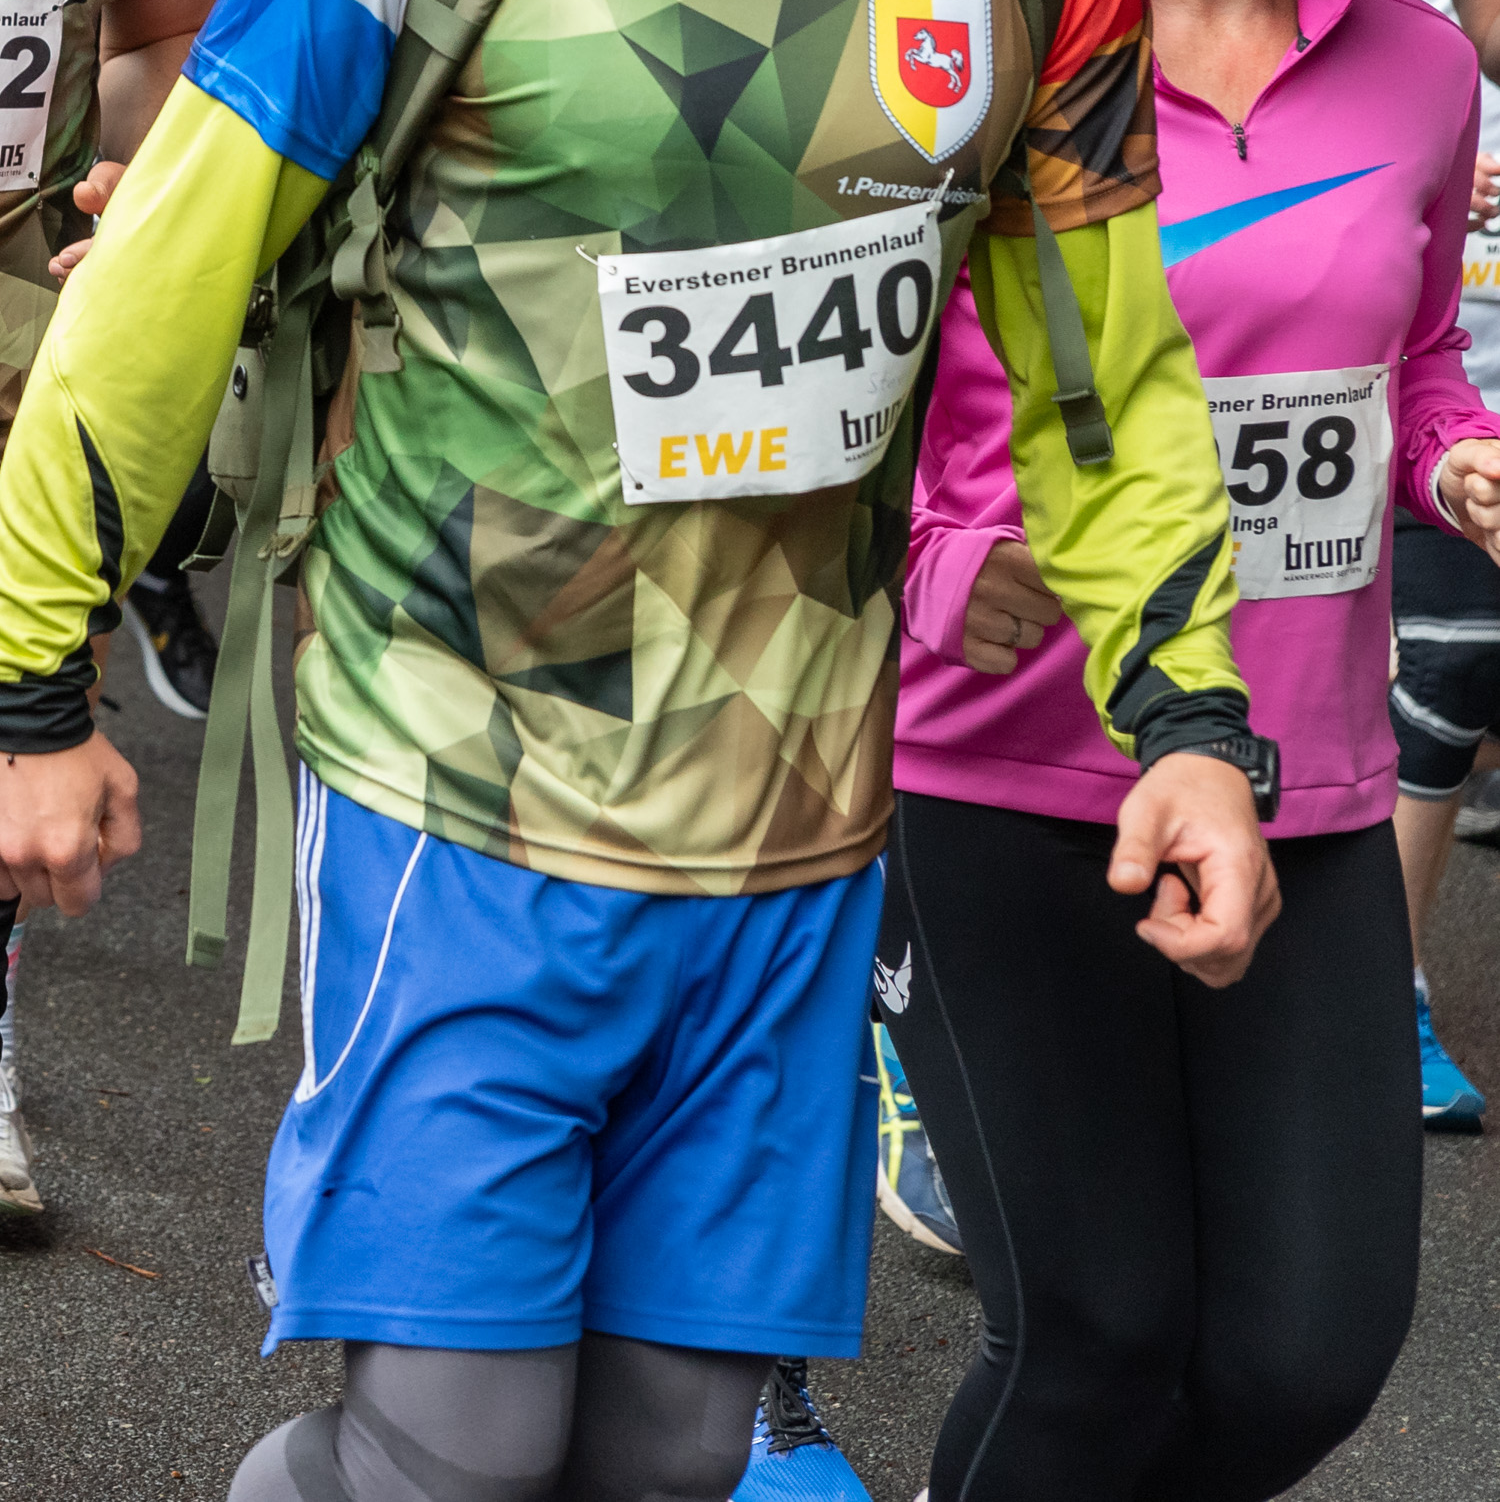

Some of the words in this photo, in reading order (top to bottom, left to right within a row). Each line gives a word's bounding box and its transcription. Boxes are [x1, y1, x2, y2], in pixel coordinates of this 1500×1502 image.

[624, 266, 773, 295] Everstener
[780, 224, 927, 276] Brunnenlauf
[618, 258, 934, 399] 3440
[1261, 382, 1374, 410] Brunnenlauf
[840, 399, 902, 451] brun
[658, 426, 789, 479] EWE
[1214, 415, 1357, 507] 58
[1232, 515, 1279, 535] Inga
[1284, 534, 1366, 571] bruns
